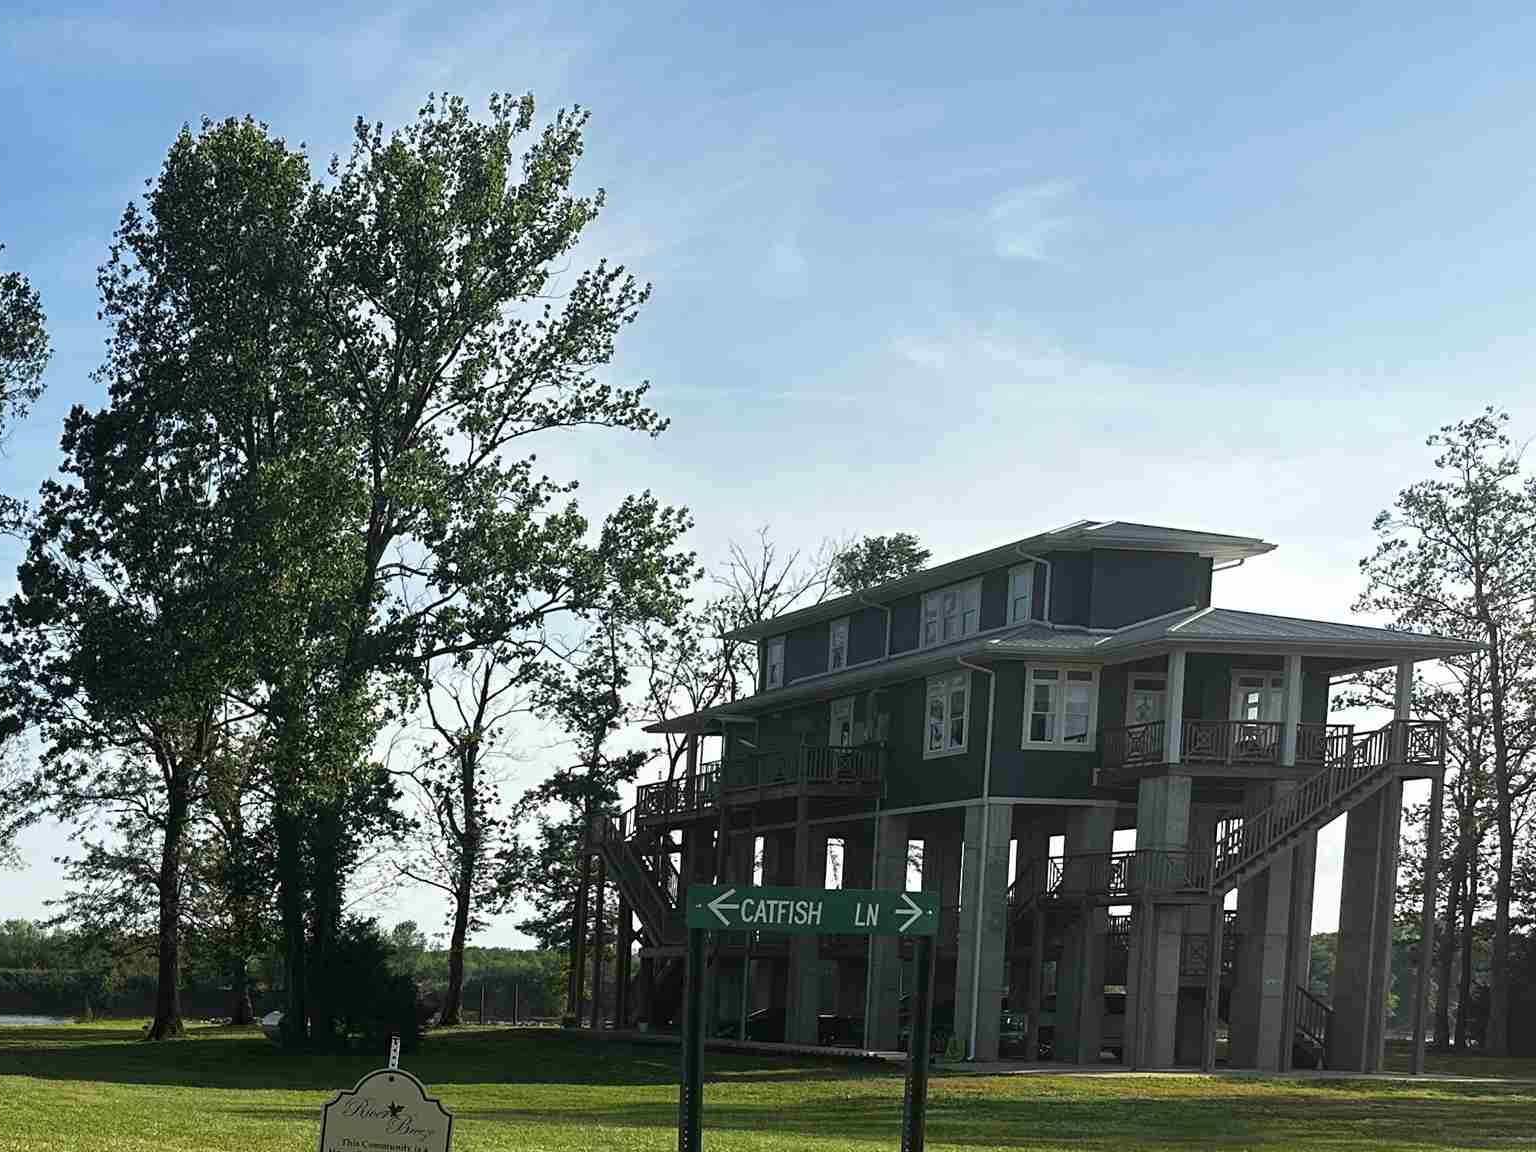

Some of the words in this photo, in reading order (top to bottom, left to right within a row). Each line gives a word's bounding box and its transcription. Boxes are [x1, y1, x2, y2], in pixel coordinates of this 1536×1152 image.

[740, 898, 824, 925] CATFISH
[855, 903, 880, 927] LN
[340, 1097, 388, 1119] River
[342, 1138, 359, 1147] This
[361, 1140, 410, 1152] Community
